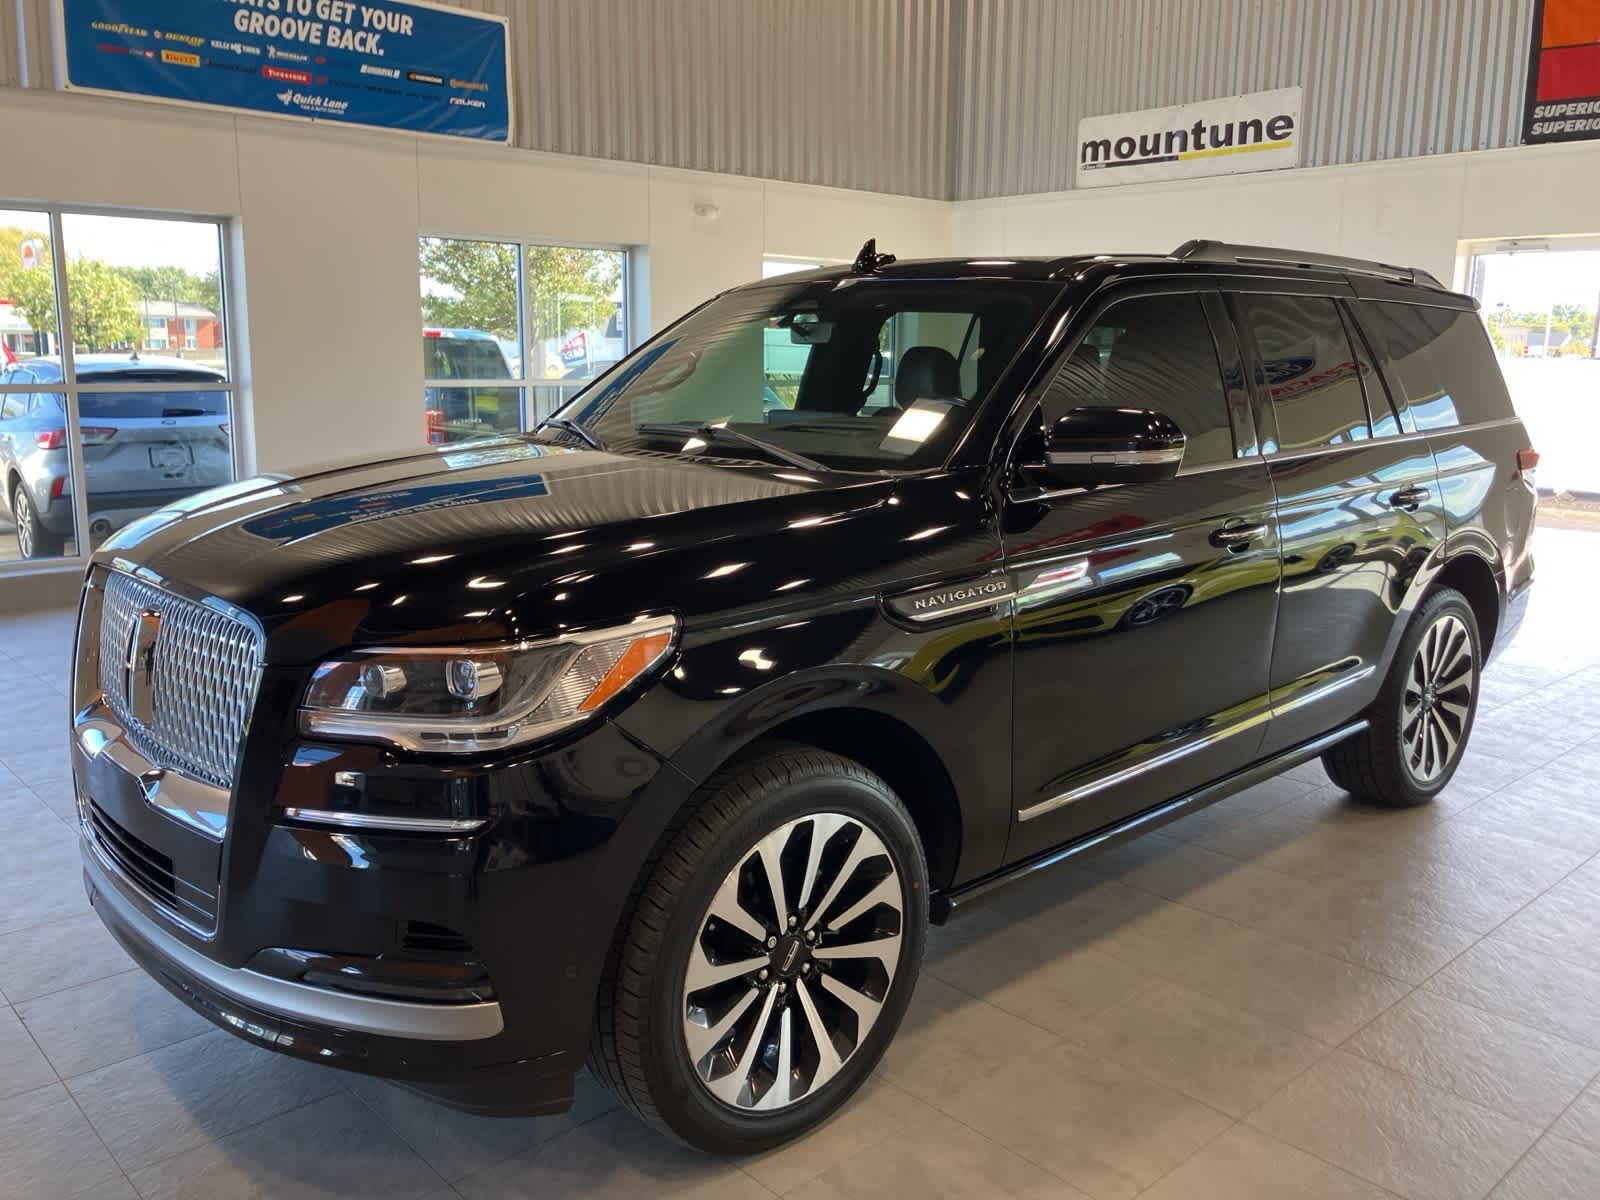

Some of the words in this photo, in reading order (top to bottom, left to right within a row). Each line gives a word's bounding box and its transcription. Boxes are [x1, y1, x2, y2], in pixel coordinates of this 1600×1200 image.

[91, 20, 148, 37] GOODYEAR
[234, 8, 323, 45] GROOVE
[326, 27, 384, 56] BACK.
[316, 0, 356, 25] GET
[361, 6, 414, 36] YOUR
[292, 93, 322, 106] Quick
[322, 97, 349, 110] Lane
[1081, 114, 1294, 163] mountune
[914, 581, 1007, 609] NAVIGATOR
